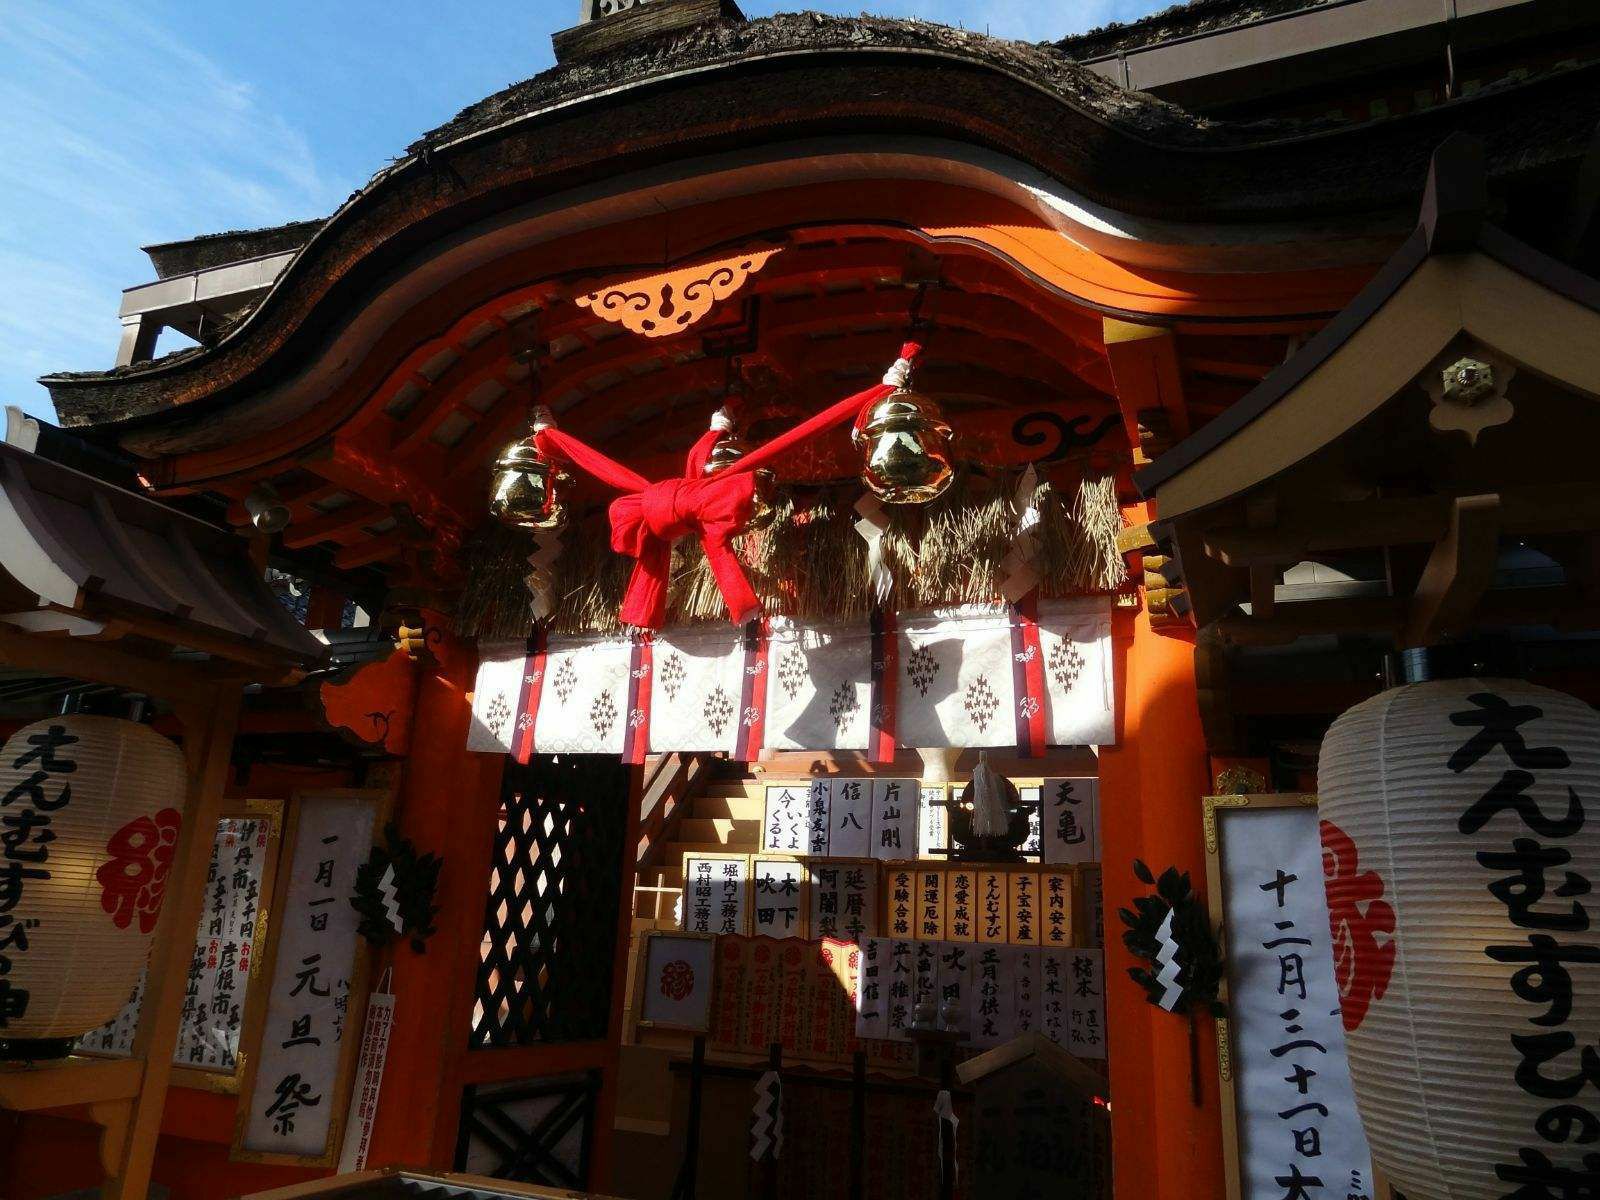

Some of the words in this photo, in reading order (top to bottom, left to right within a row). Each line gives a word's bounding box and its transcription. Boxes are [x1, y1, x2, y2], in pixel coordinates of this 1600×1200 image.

[769, 809, 781, 848] くるよ
[778, 789, 802, 849] 今いくよ
[881, 781, 903, 848] 片山剛
[694, 862, 712, 932] 西村昭工務店
[720, 863, 738, 932] 堀内工務店
[778, 872, 799, 928] 木下
[844, 868, 866, 938] 延暦寺
[894, 873, 910, 934] 受験合格
[923, 874, 939, 936] 開運厄除
[954, 874, 970, 937] 恋愛成就
[985, 875, 1001, 938] えんむすび
[1016, 876, 1032, 940] 子宝安産
[1048, 876, 1064, 941] 家内安全
[212, 941, 238, 1015] 彦根市
[265, 835, 339, 1136] 一月一日元旦祭
[862, 939, 880, 1019] 吉田信一
[979, 949, 1001, 1037] 正月お供え
[1259, 869, 1328, 1200] 十二月三十一日大
[1347, 1169, 1369, 1200] 三
